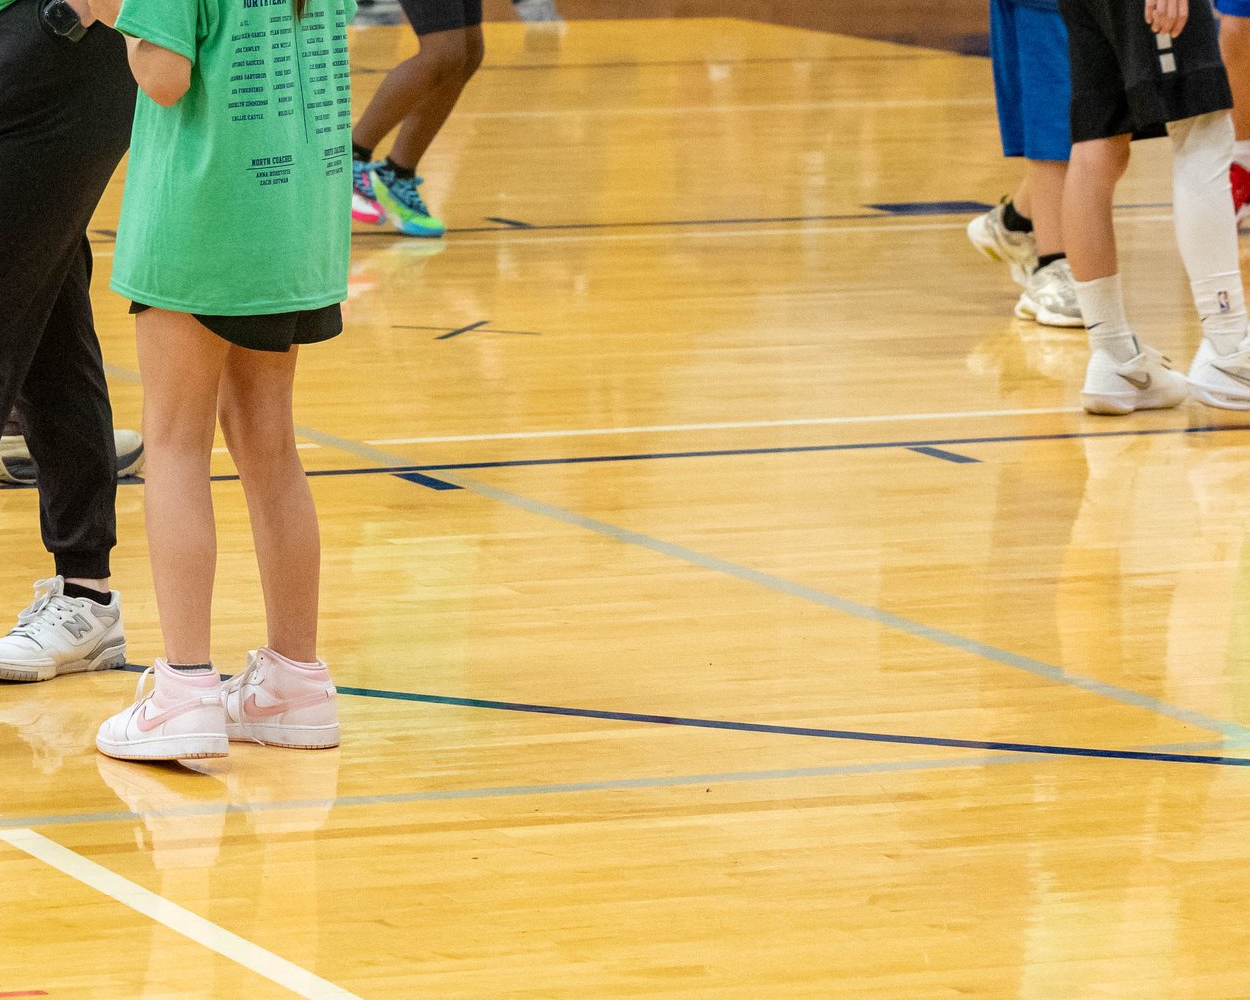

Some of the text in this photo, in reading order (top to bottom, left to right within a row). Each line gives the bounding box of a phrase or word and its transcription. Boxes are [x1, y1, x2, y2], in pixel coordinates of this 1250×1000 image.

[251, 155, 293, 167] NORTH COACHES
[61, 613, 94, 640] N
